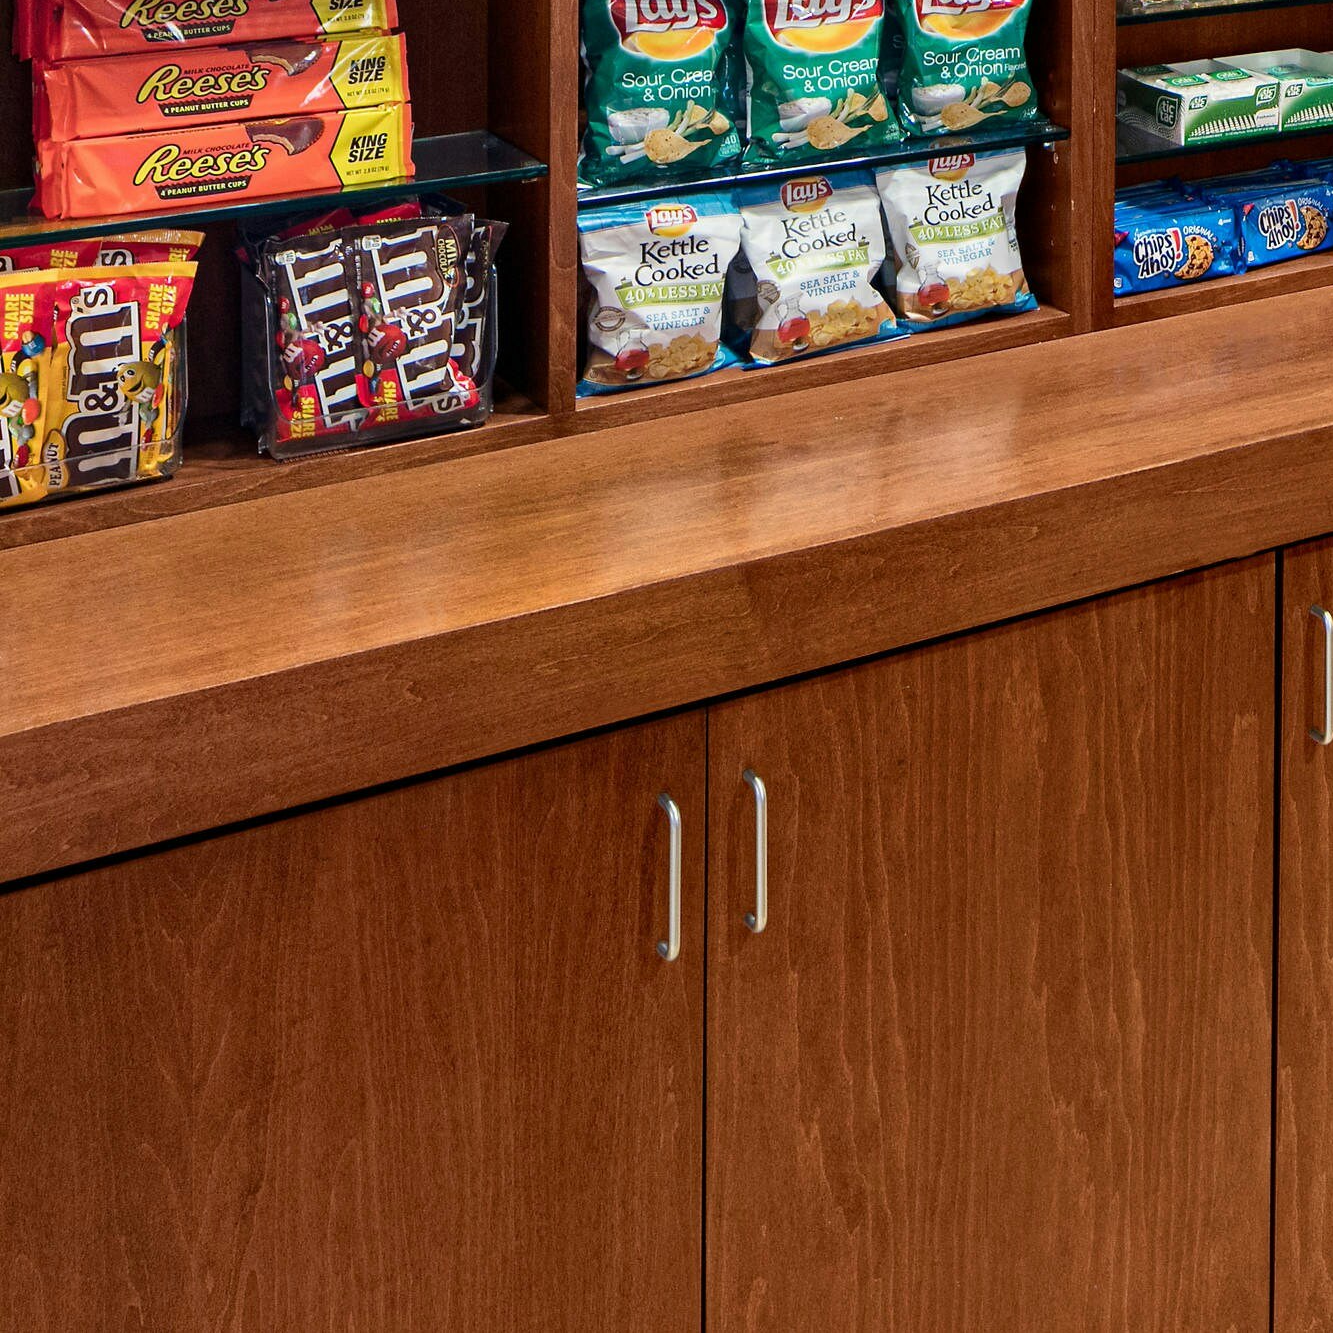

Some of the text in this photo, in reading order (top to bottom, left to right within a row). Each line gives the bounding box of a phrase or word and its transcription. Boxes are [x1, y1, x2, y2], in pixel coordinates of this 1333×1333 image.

[350, 56, 385, 72] KING
[924, 47, 1020, 65] Sour Cream
[348, 69, 384, 84] SIZE
[941, 62, 1004, 79] & Onion
[138, 65, 270, 103] Reese's
[183, 143, 250, 154] MILK CHOCOLATE
[350, 133, 388, 150] KING
[348, 146, 385, 163] SIZE
[134, 144, 270, 185] Reese's
[160, 180, 247, 196] 4 PEANUT BUTTER CUPS
[640, 235, 709, 264] Kettle
[1134, 236, 1173, 260] Chips
[635, 254, 720, 286] Cooked
[146, 283, 164, 330] SHARE
[162, 285, 177, 314] SIZE
